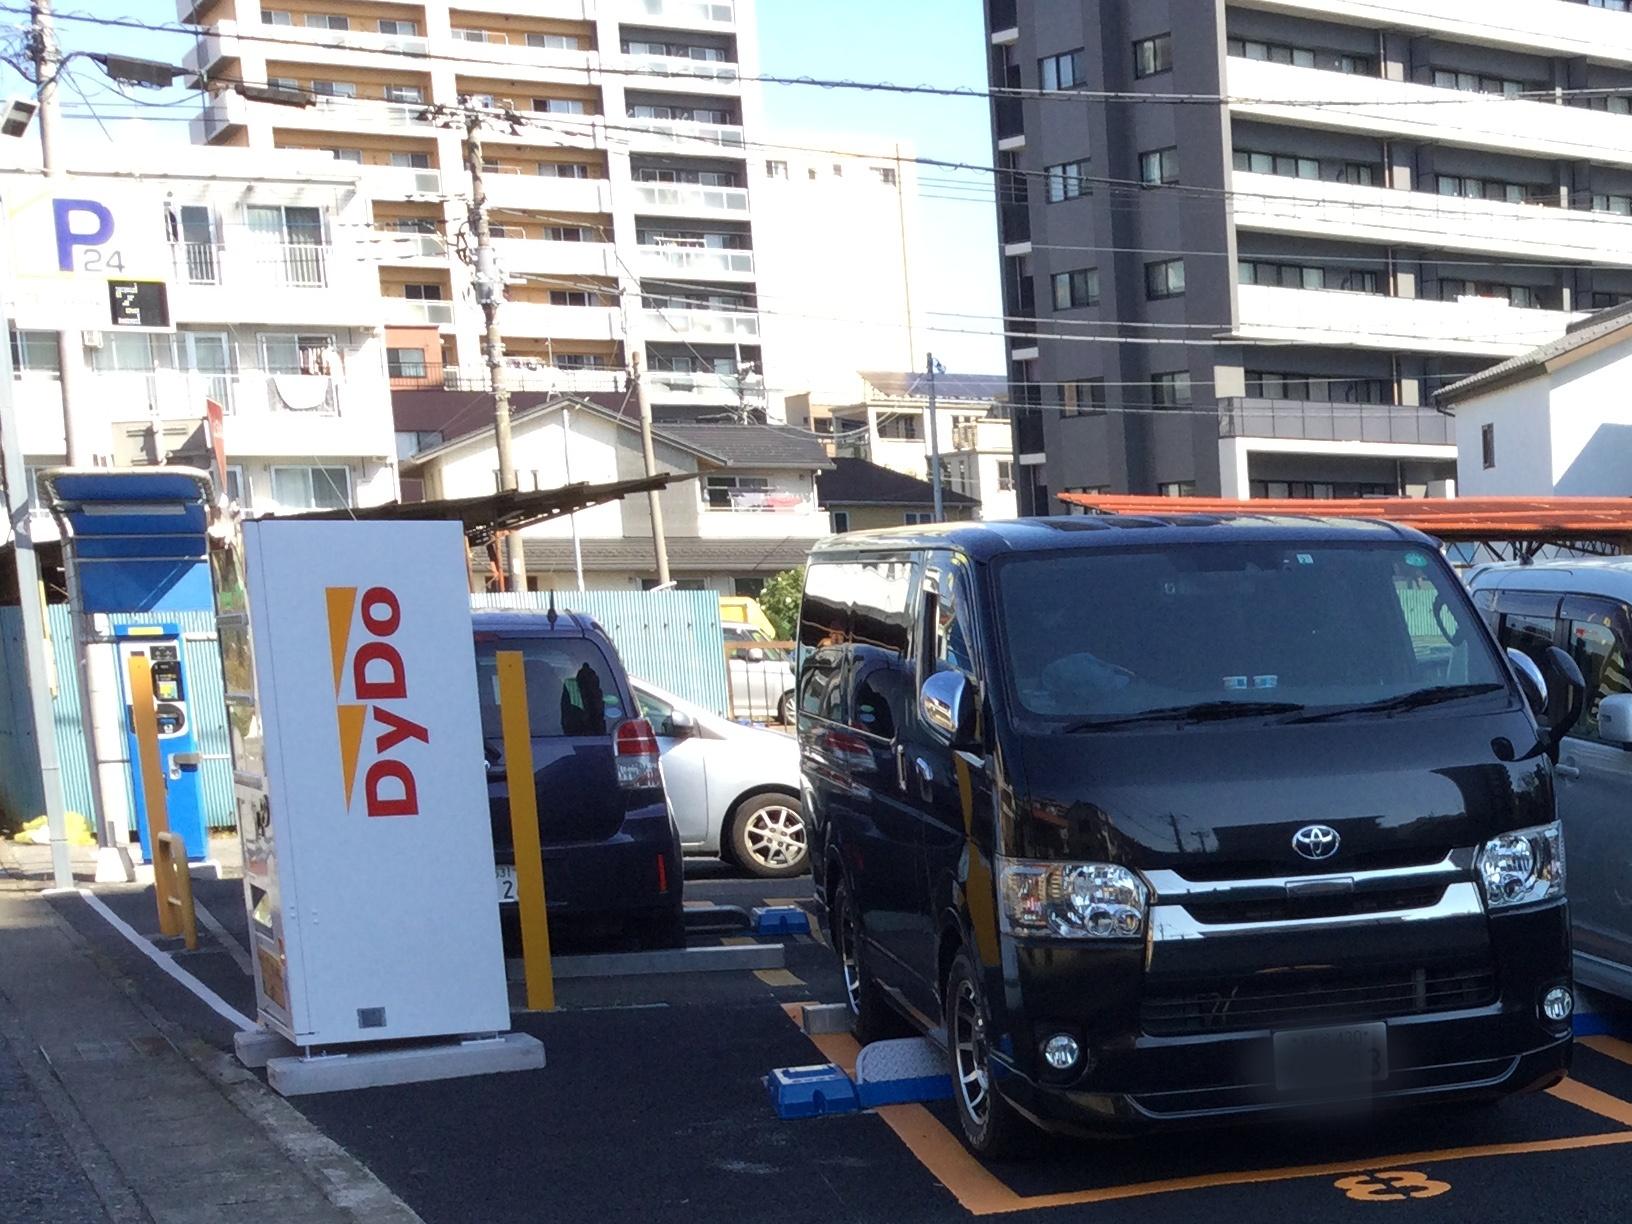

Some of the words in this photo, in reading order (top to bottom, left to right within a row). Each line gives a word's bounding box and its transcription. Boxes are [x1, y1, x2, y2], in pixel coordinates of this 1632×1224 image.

[52, 198, 115, 272] P
[84, 248, 125, 273] 24
[353, 586, 430, 818] DyDo
